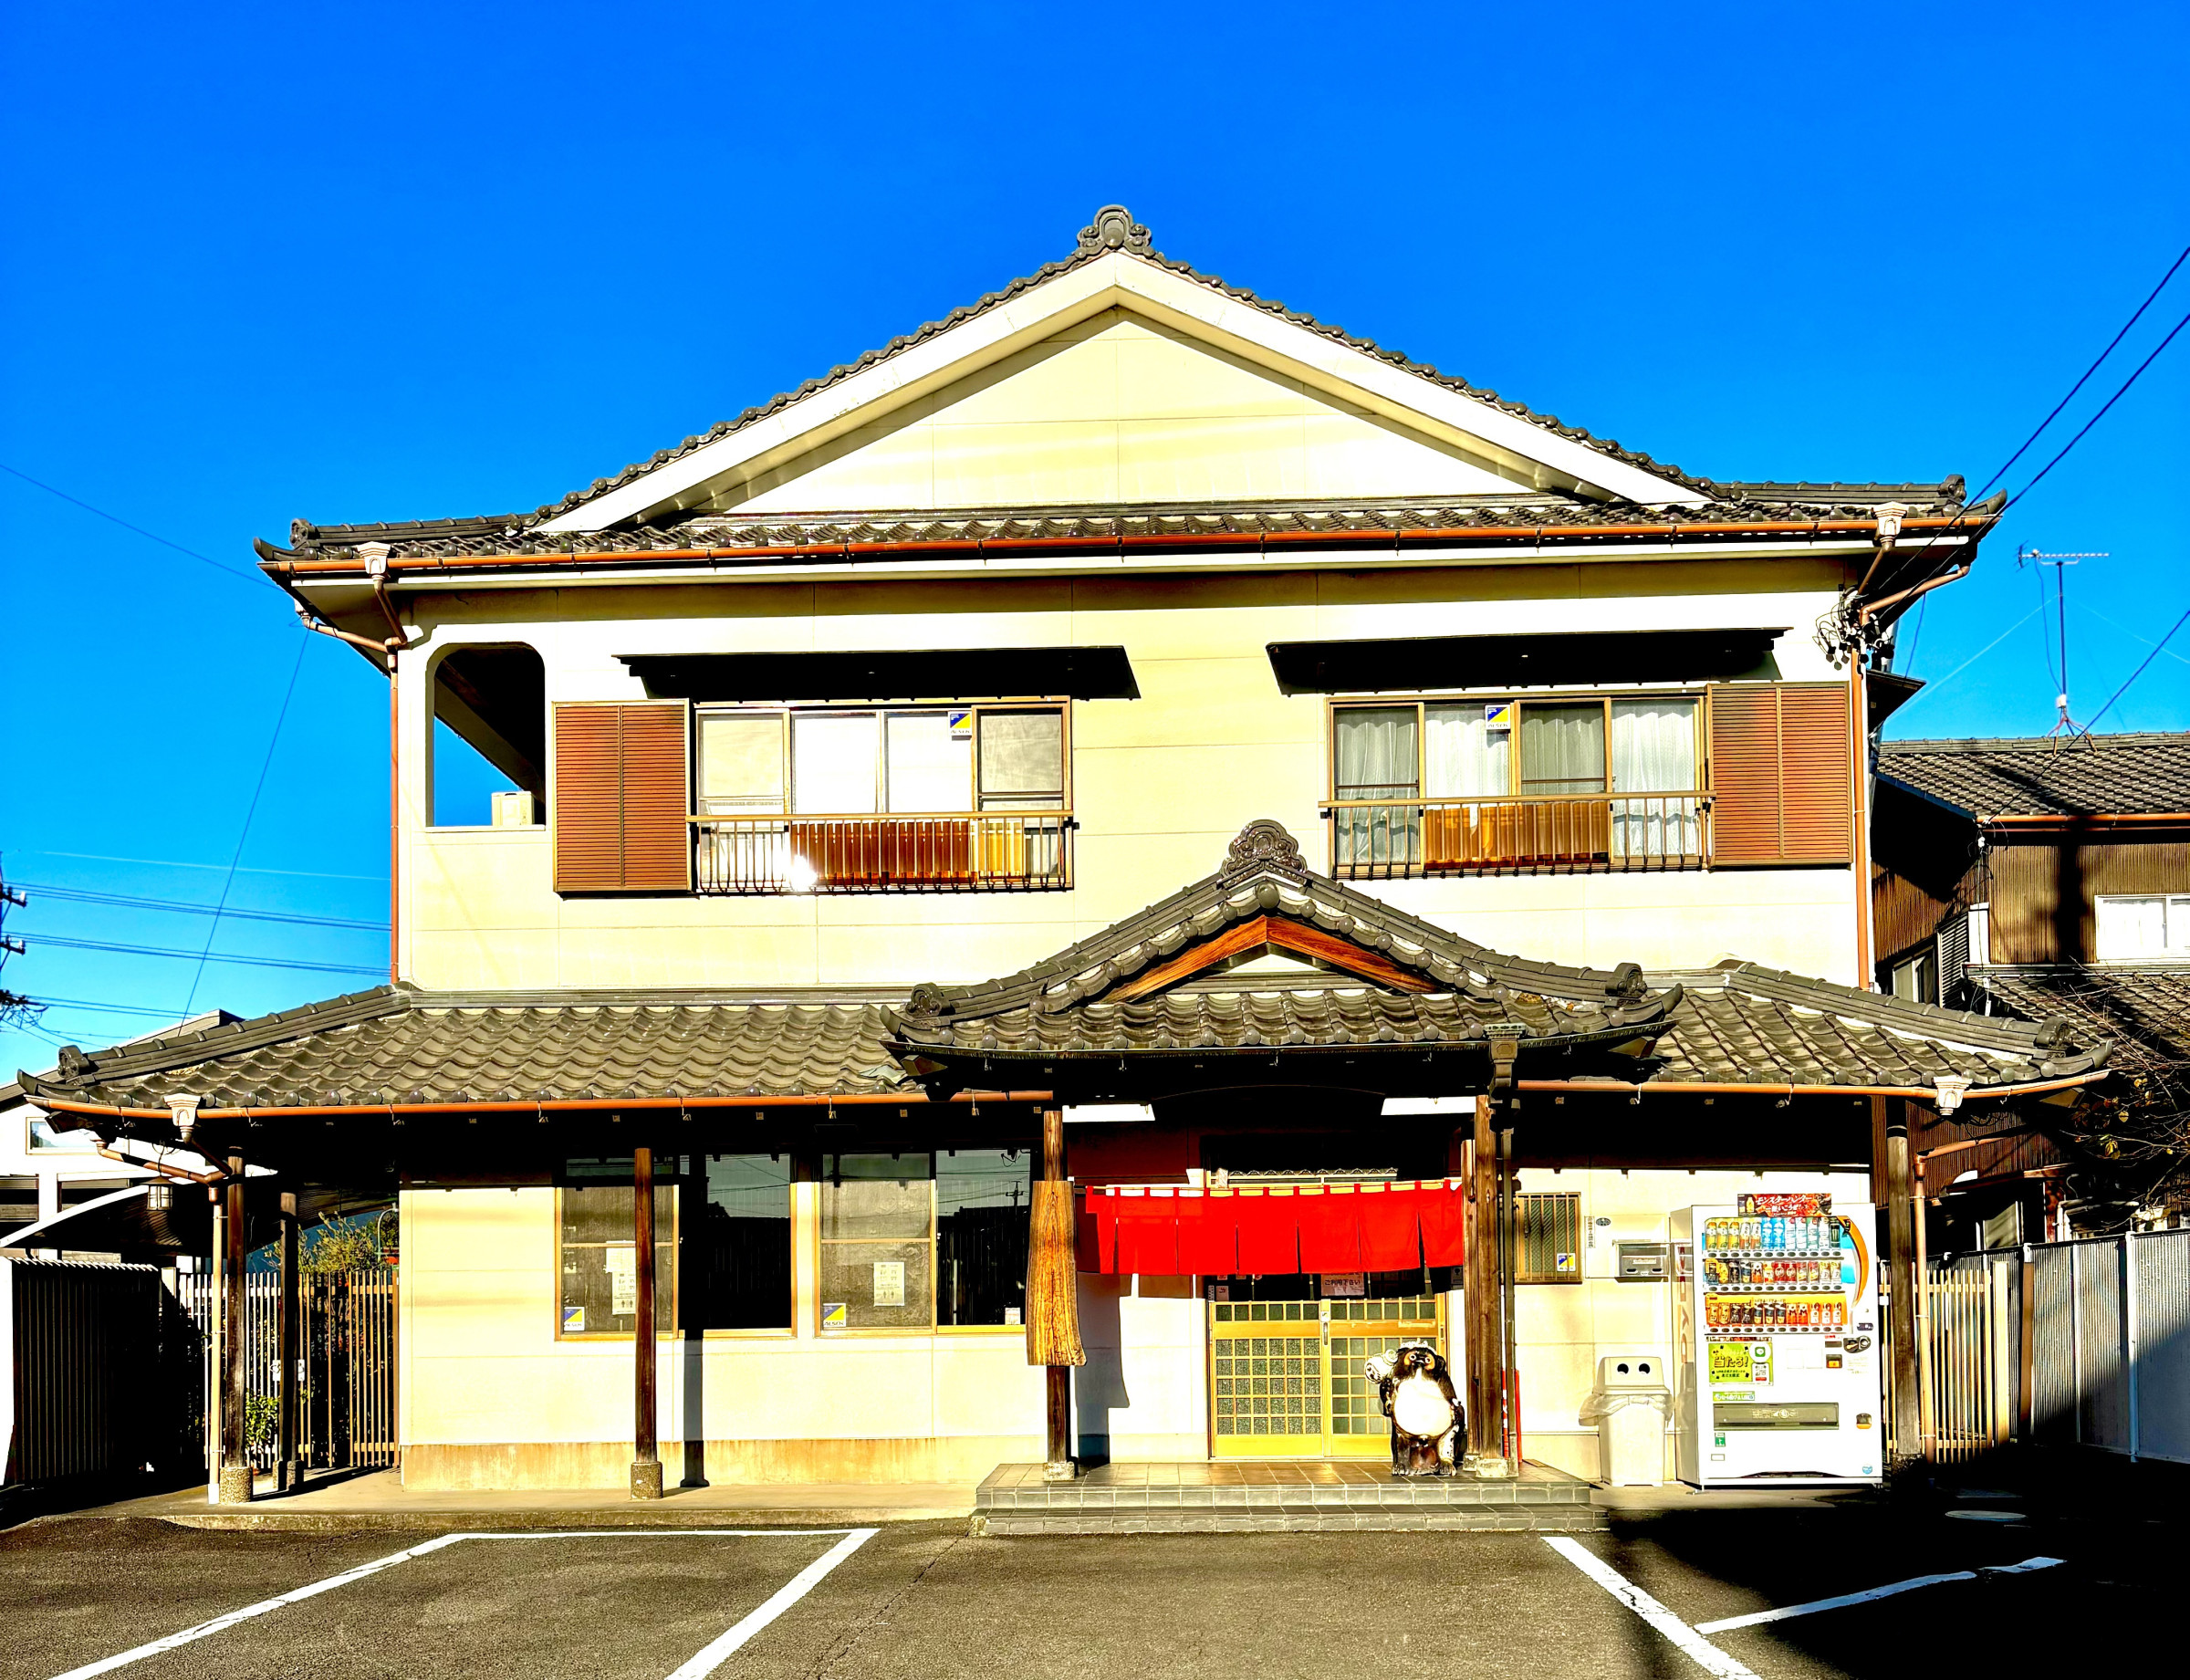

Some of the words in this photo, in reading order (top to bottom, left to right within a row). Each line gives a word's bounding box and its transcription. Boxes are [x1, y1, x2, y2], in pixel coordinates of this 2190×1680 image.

[1755, 1194, 1812, 1205] モンスターハンター
[1714, 1355, 1749, 1368] 当たる!
